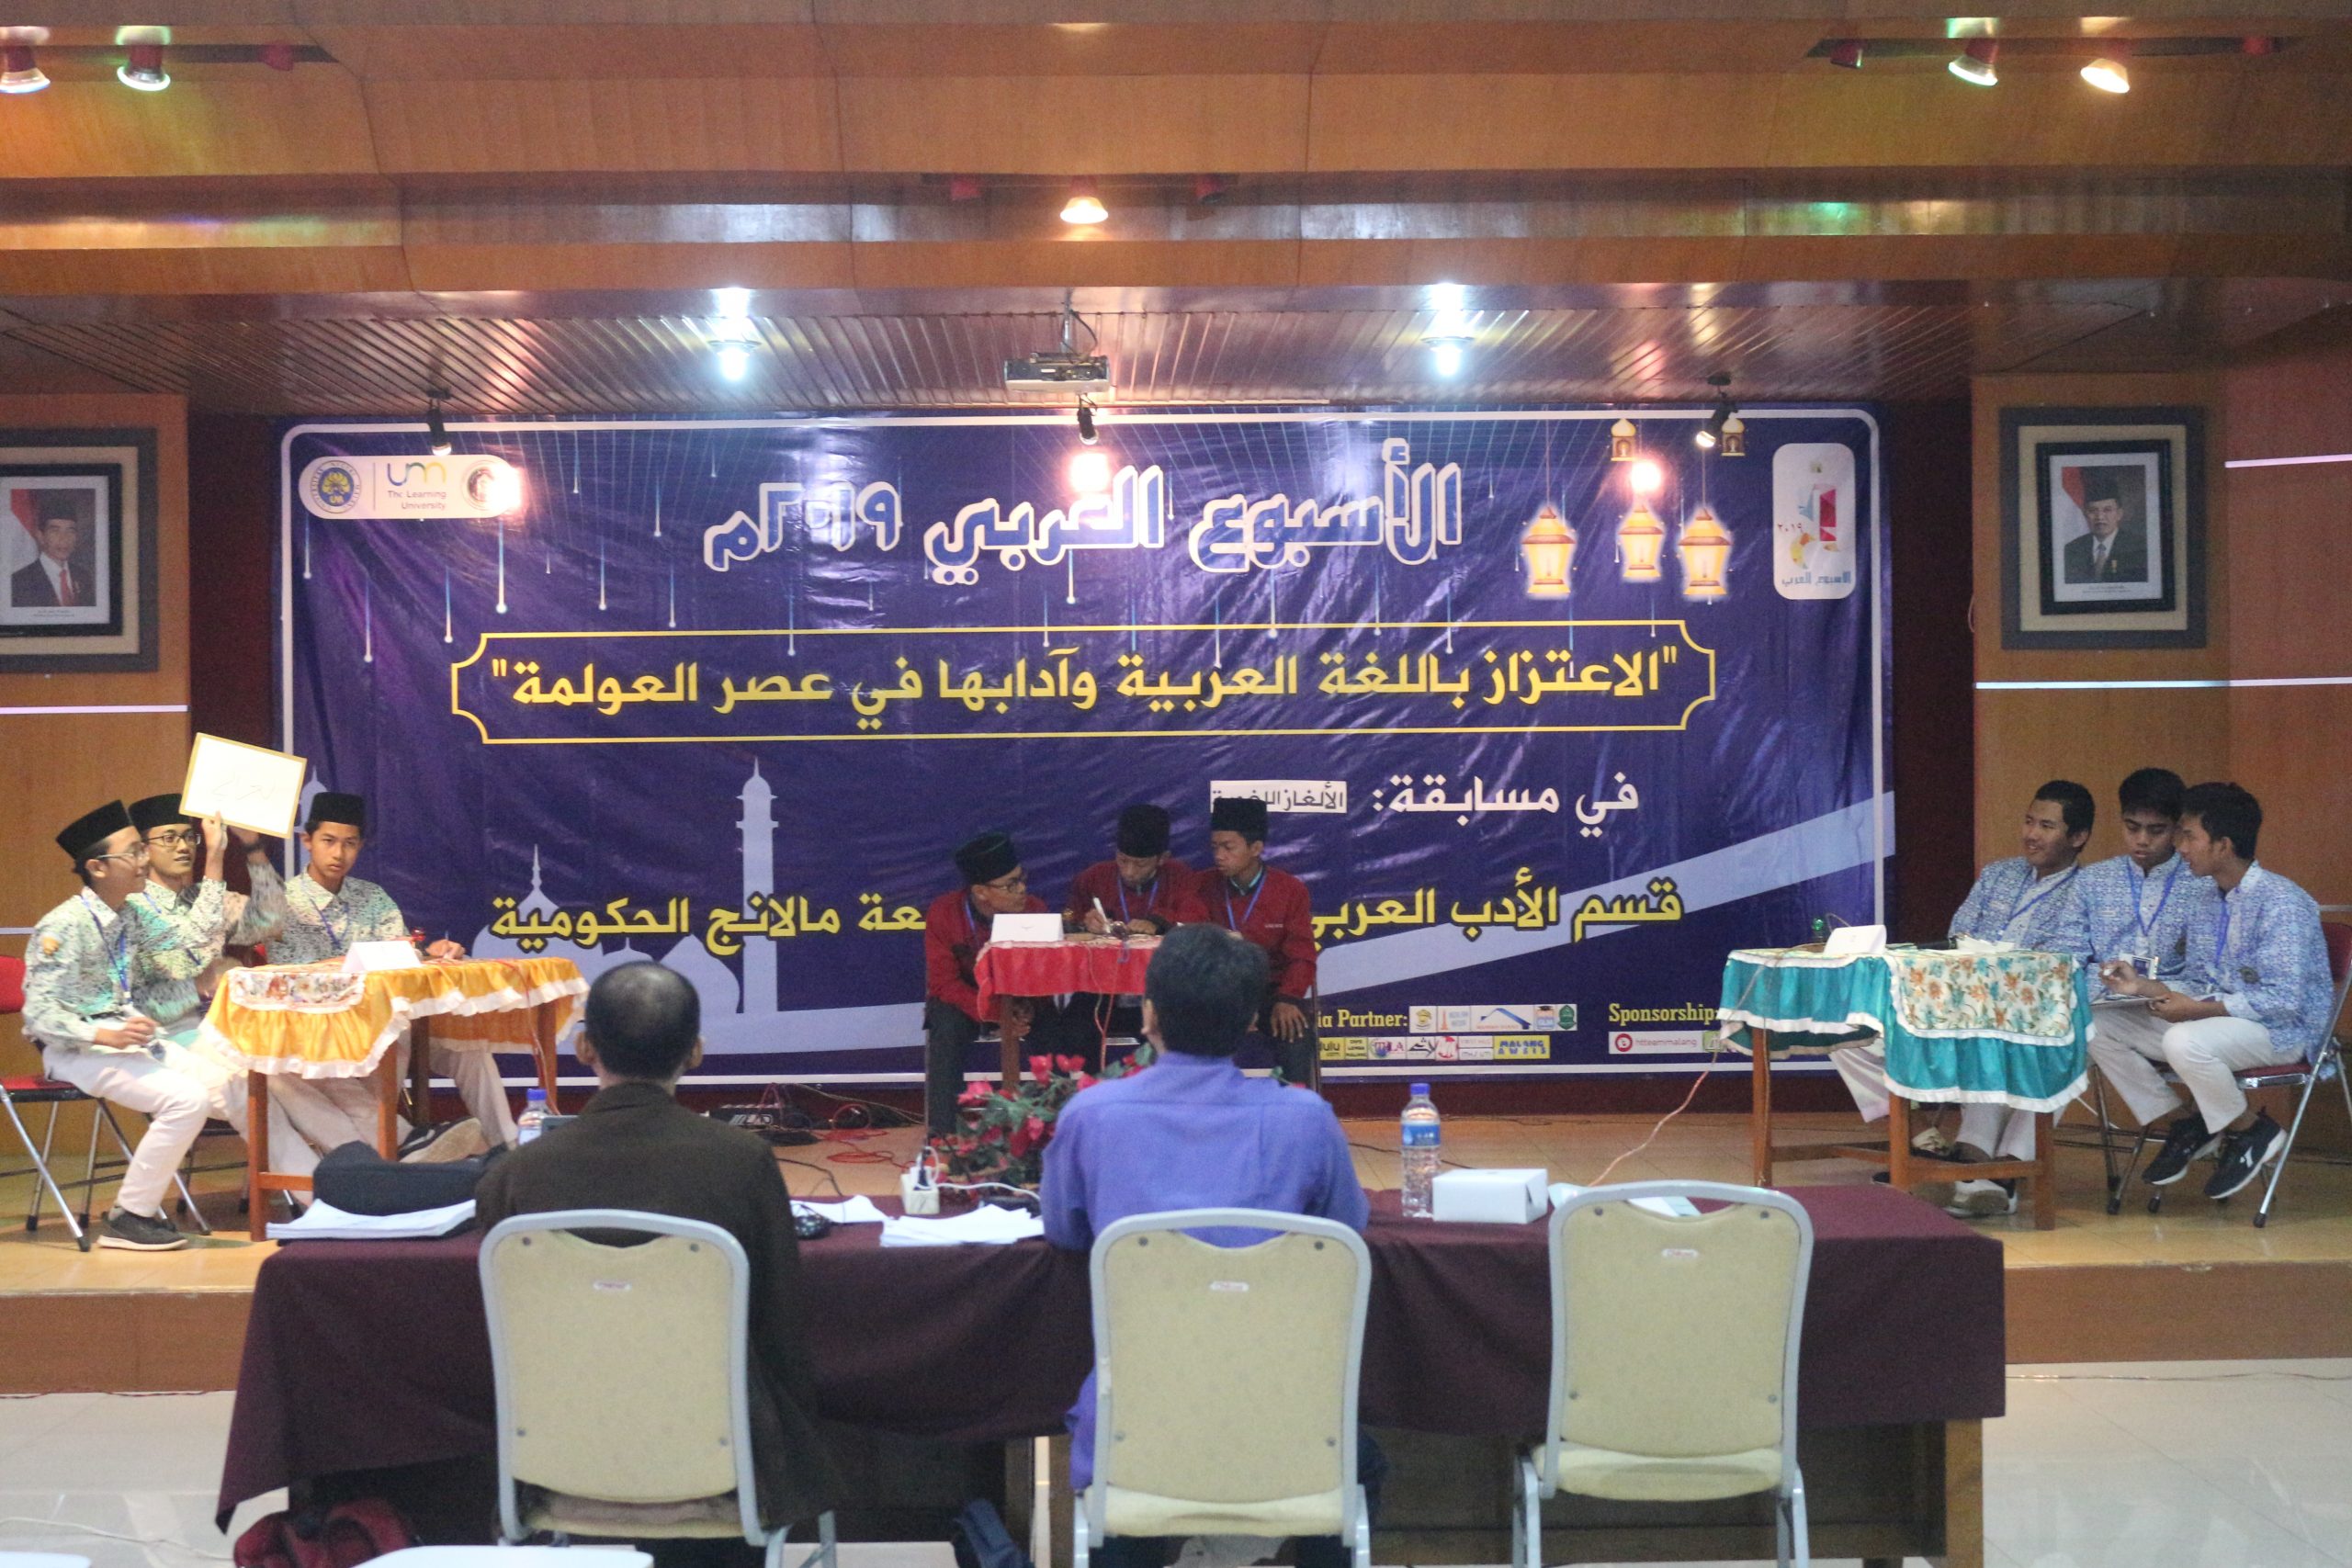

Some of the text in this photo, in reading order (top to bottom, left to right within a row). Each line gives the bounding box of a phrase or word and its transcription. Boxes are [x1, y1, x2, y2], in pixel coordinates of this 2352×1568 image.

[401, 502, 446, 511] University
[406, 490, 447, 501] Learning
[923, 464, 1165, 585] العربي
[1189, 438, 1462, 573] الأسبوع
[715, 673, 831, 713] عصر
[852, 656, 922, 729] في
[940, 648, 1098, 714] وآدابها
[1117, 653, 1298, 712] العربية
[1318, 651, 1470, 709] باللغة
[1372, 772, 1639, 838] في مسابقة:
[492, 897, 689, 949] الحكومية
[707, 896, 841, 955] مالانج
[1451, 867, 1557, 937] الأدب
[1574, 882, 1681, 942] قسم
[1338, 1009, 1408, 1028] Partner:
